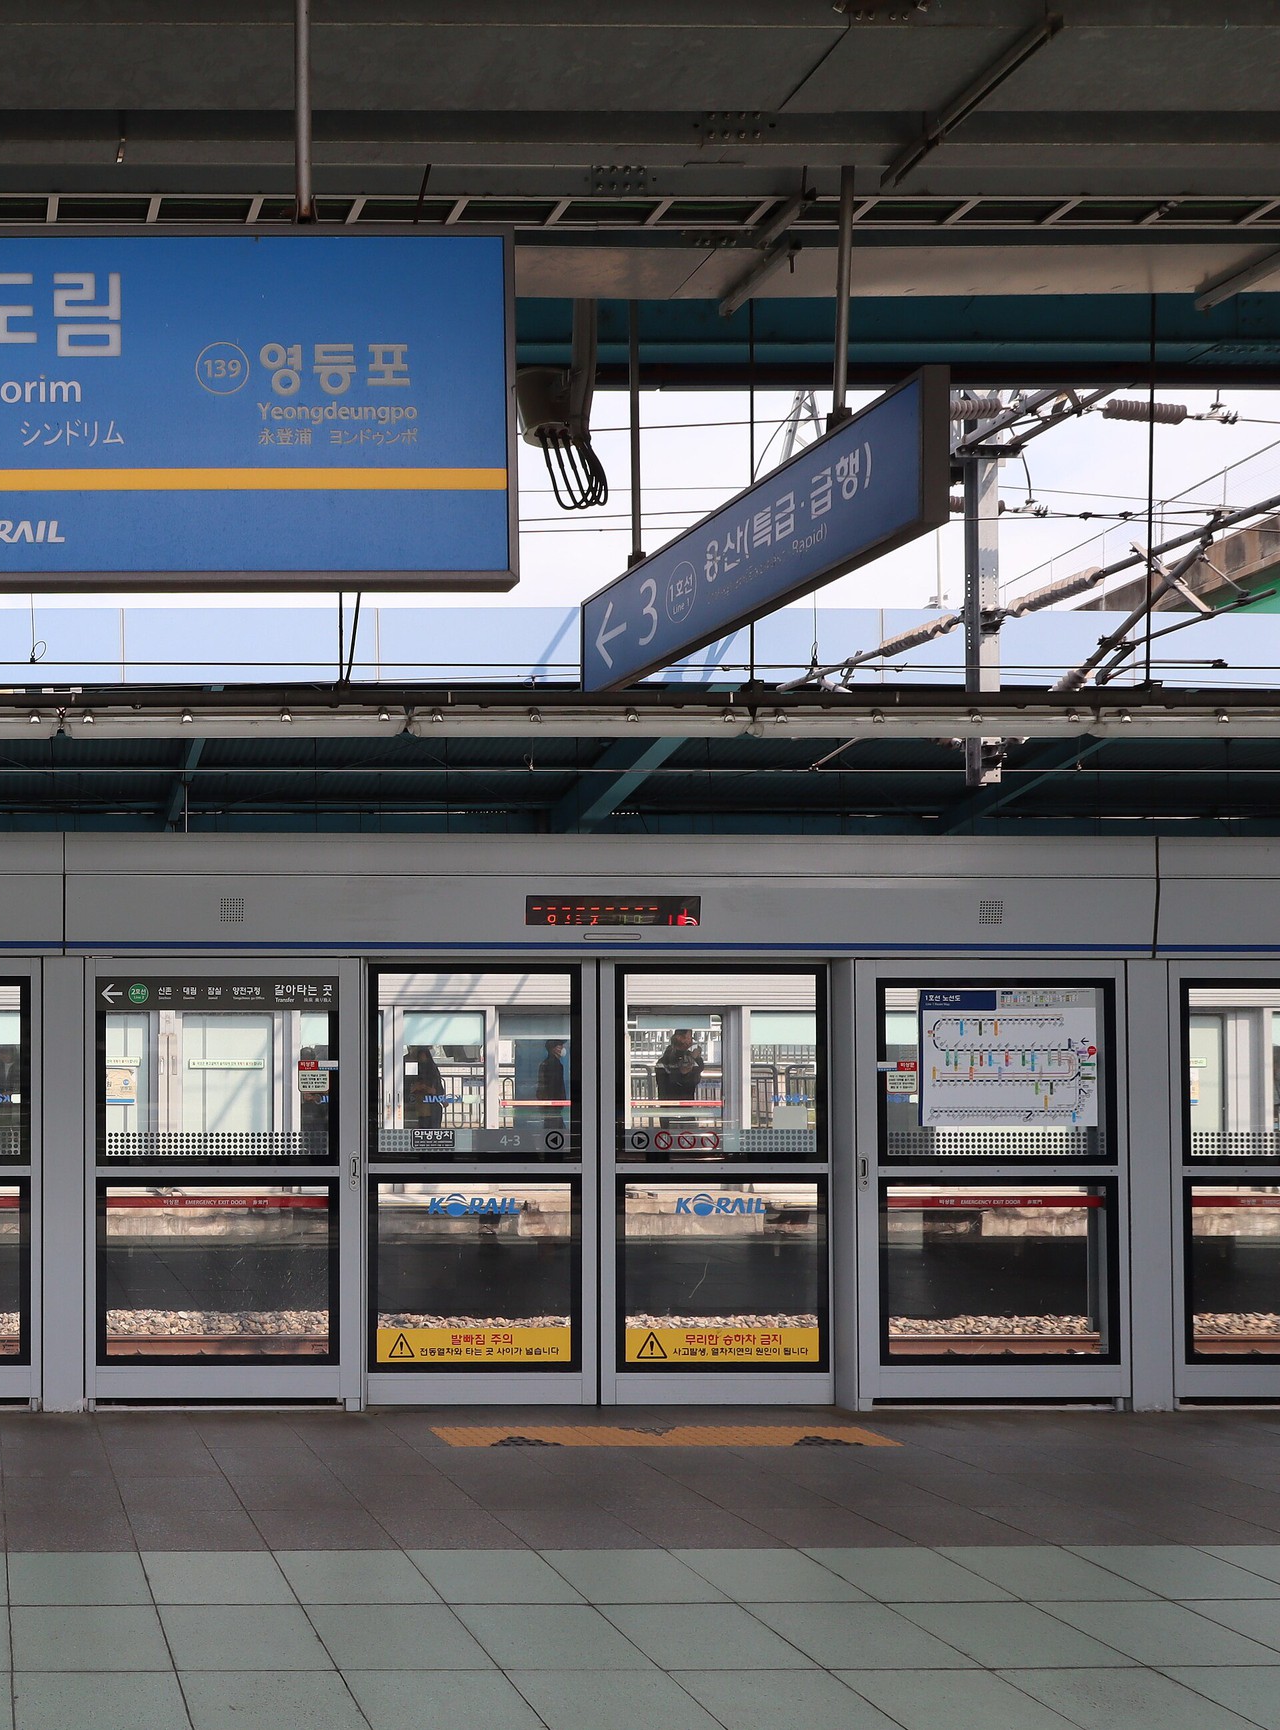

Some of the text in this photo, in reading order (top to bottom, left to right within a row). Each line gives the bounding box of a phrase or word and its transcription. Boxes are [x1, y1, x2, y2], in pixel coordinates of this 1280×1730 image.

[203, 343, 411, 395] 139 영등포
[257, 402, 418, 424] Yeongdeungpo
[20, 420, 125, 447] シンドリム
[258, 427, 419, 446] 永登浦 ヨンドゥンポ
[638, 578, 658, 646] 3
[670, 574, 693, 602] 1호선
[672, 603, 685, 615] Line
[158, 986, 172, 996] 신촌
[182, 986, 197, 996] 대림
[207, 986, 222, 996] 잠실
[232, 986, 261, 996] 양천구청
[274, 984, 333, 996] 갈아타는 곳
[414, 1130, 454, 1140] 약냉방차
[500, 1137, 521, 1146] 4-3
[427, 1193, 520, 1216] KORAIL
[675, 1193, 767, 1216] KORAIL
[451, 1334, 513, 1345] 발빠짐 주의
[685, 1334, 782, 1345] 무리한 승하차 금지
[420, 1347, 559, 1356] 전동열차와 타는 곳 사이가 넓습니다
[673, 1347, 808, 1356] 사고발생, 열차지연의 원인이 됩니다
